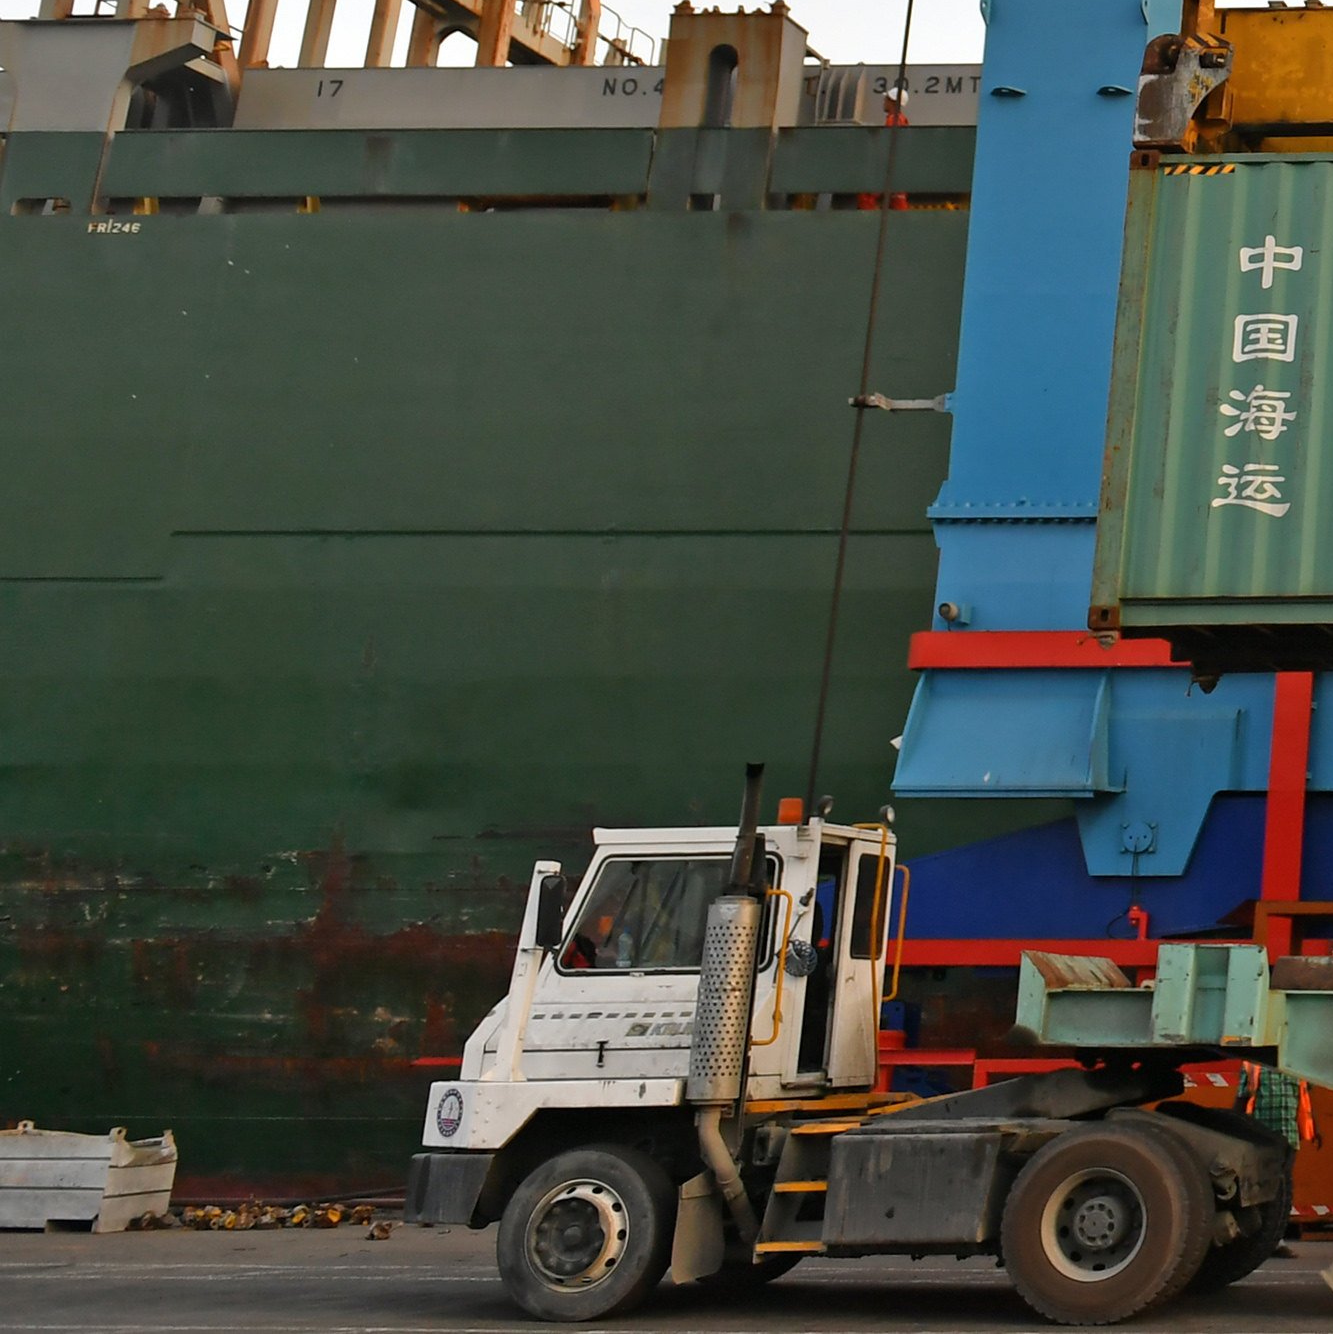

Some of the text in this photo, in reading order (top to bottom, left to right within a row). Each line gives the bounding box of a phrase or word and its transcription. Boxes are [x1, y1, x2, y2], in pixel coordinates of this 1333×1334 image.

[317, 80, 344, 97] 17
[1211, 234, 1304, 518] 中国海运
